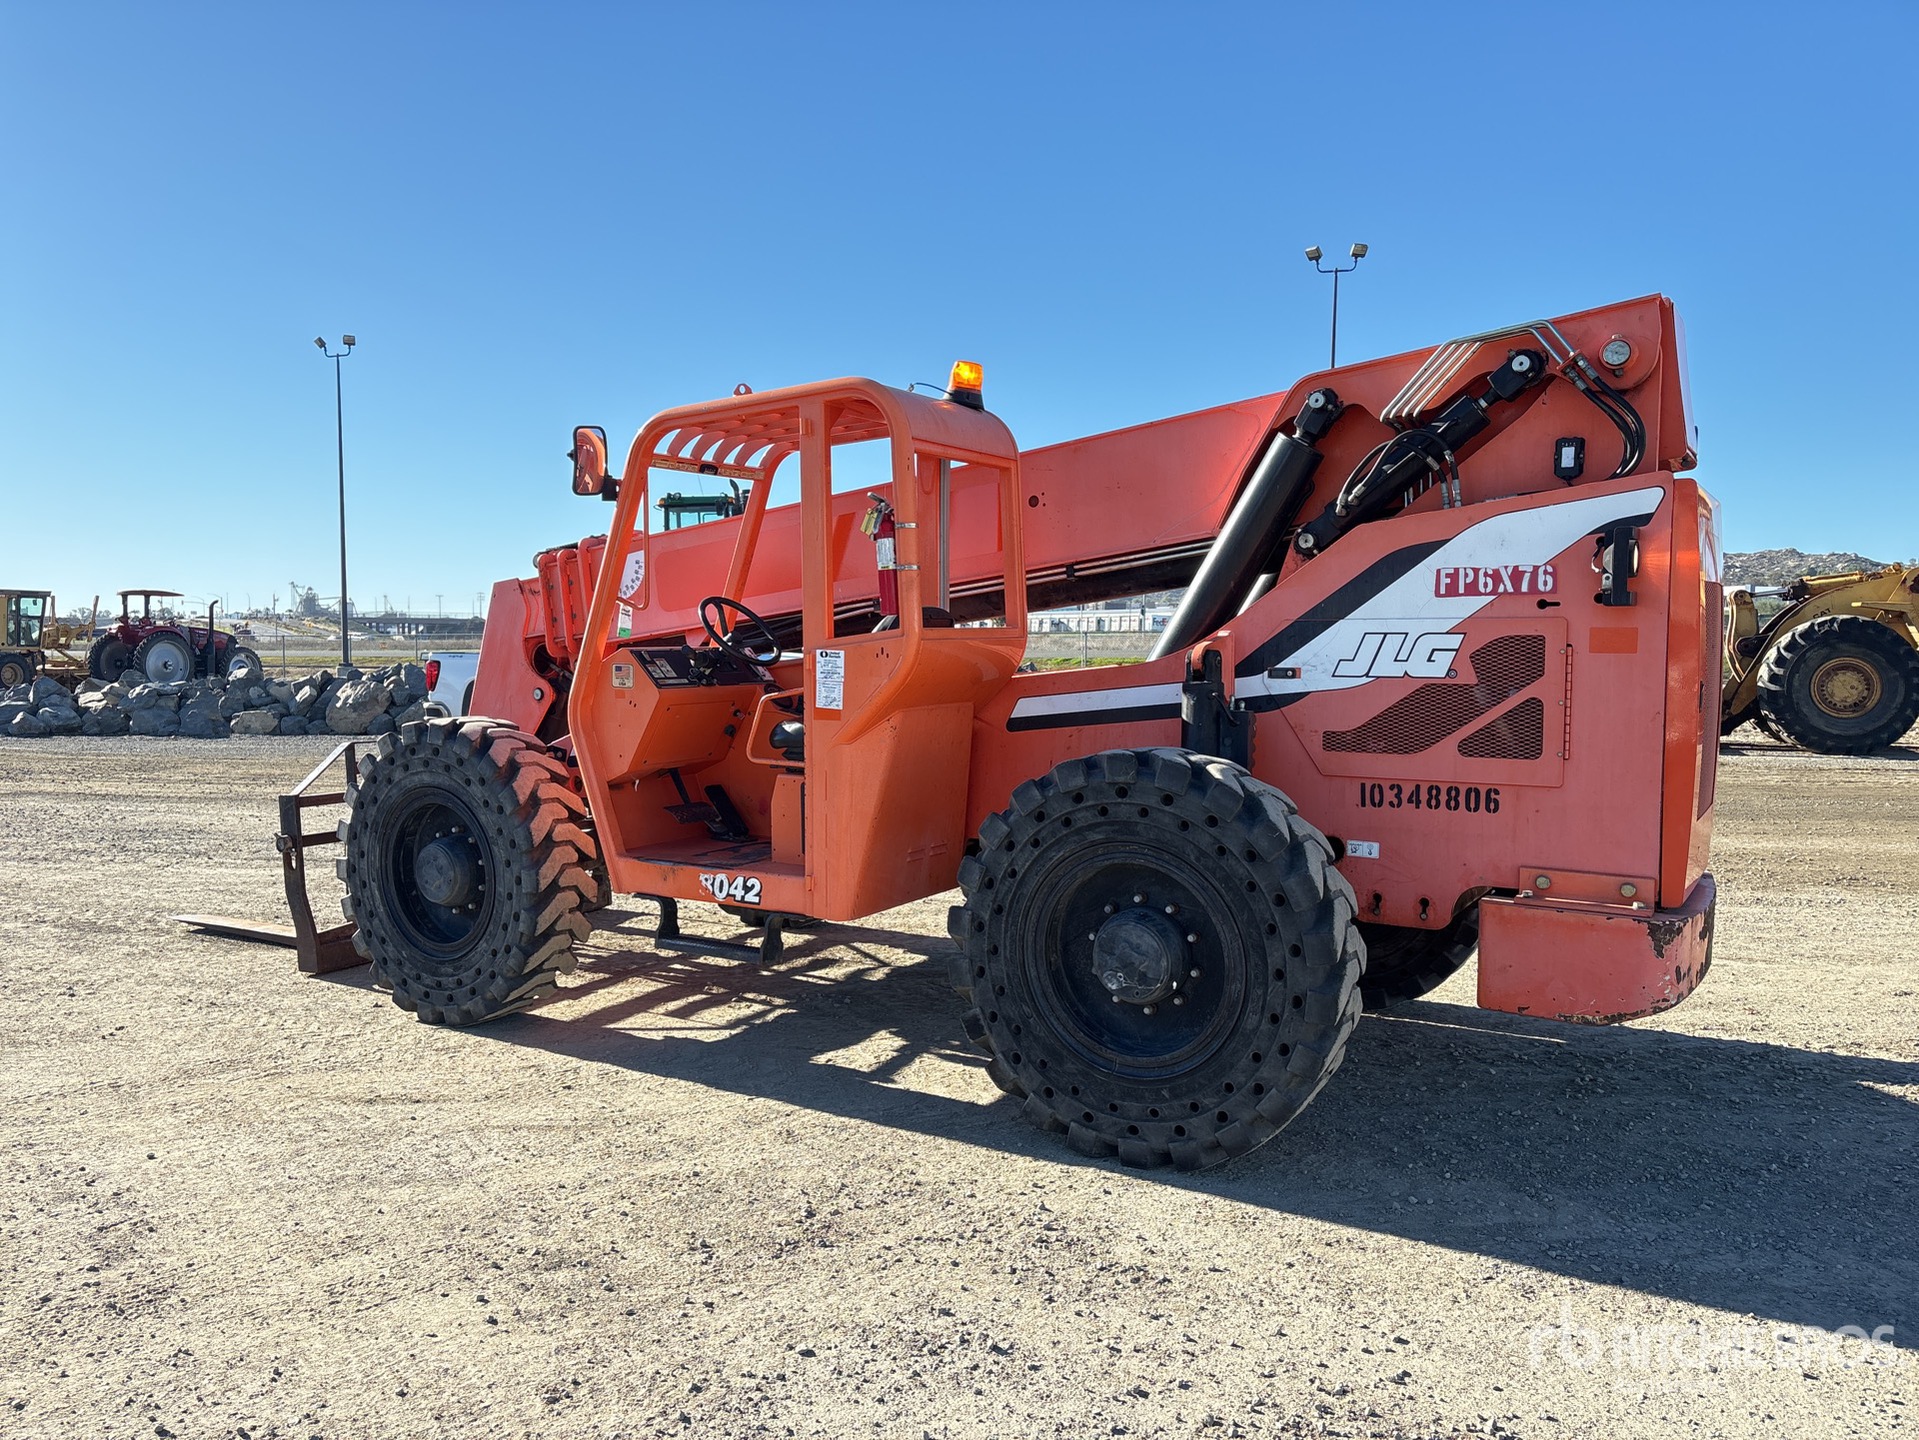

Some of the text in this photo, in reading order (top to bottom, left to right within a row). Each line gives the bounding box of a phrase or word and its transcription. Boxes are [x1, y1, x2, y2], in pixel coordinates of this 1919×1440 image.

[1439, 565, 1554, 594] FP6X76
[1812, 608, 1831, 619] CAT
[1331, 632, 1467, 679] JLG
[1360, 782, 1500, 814] 10348806
